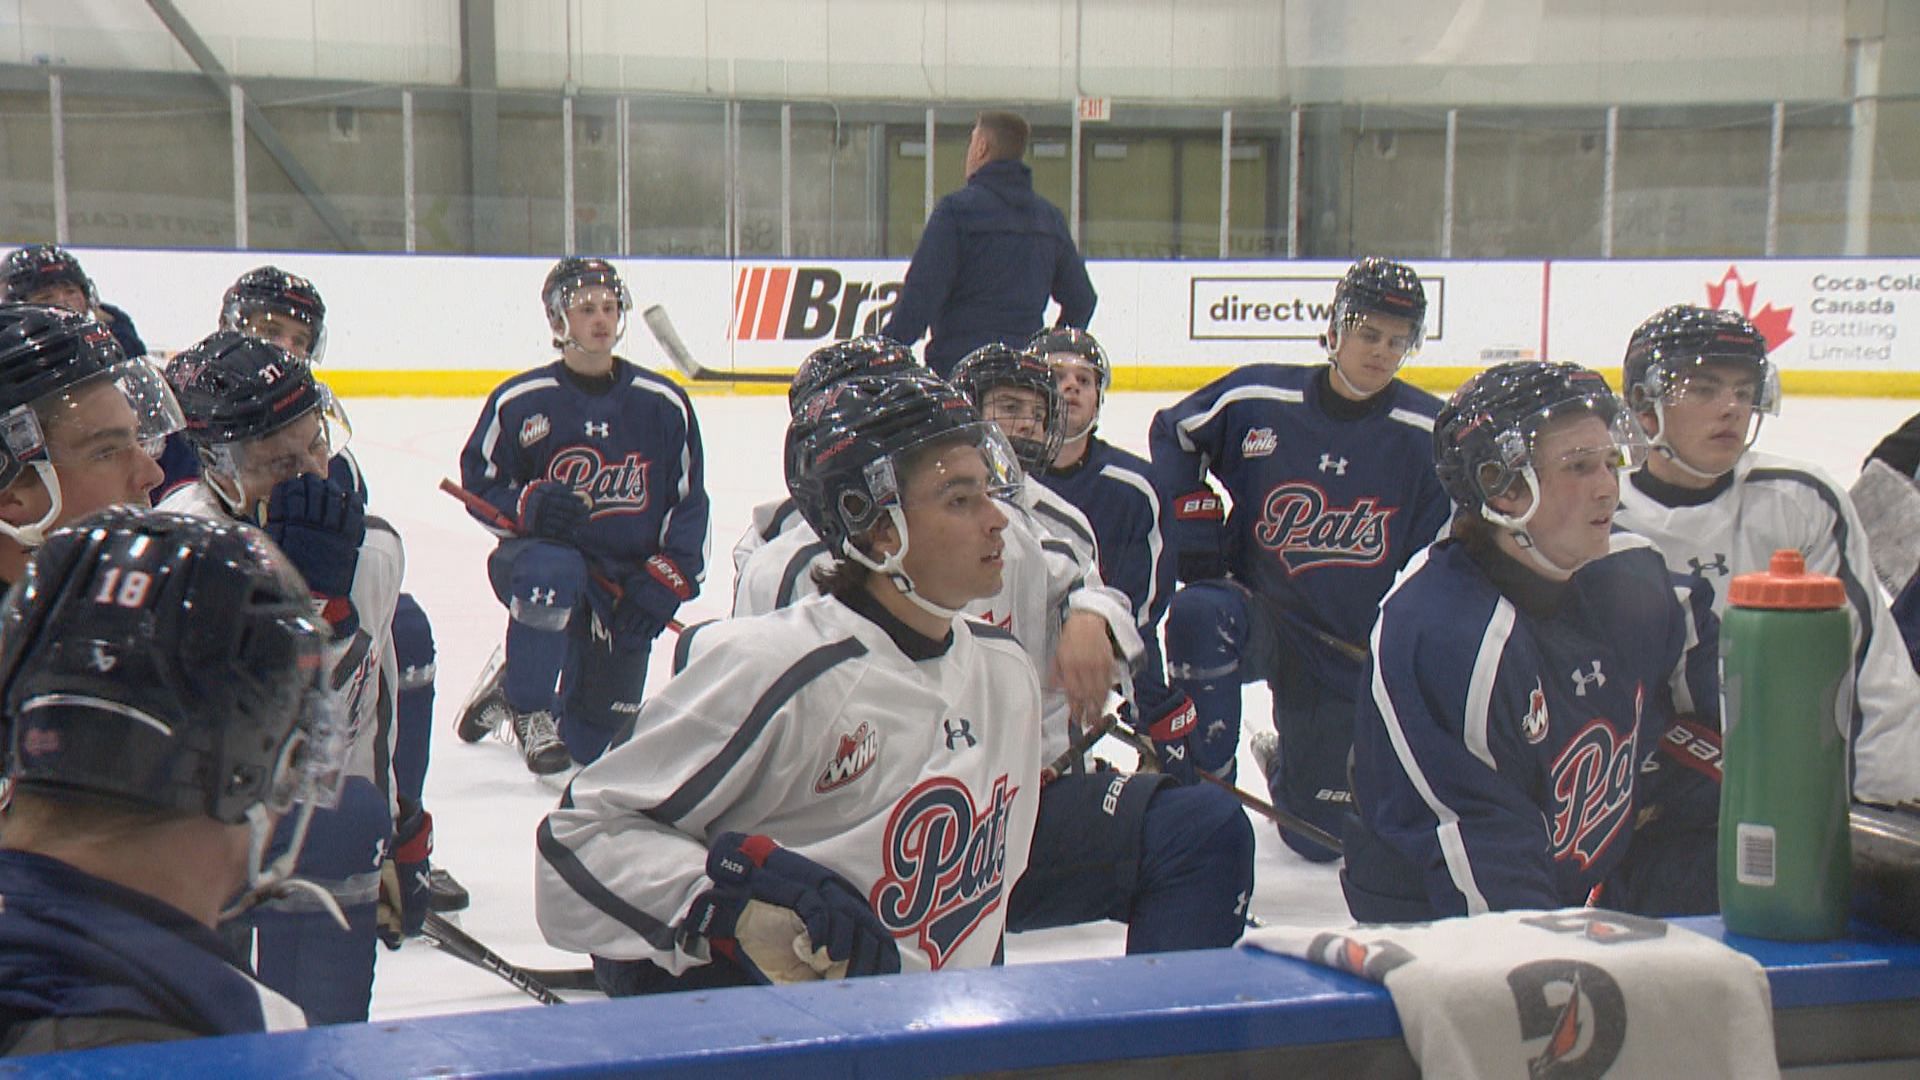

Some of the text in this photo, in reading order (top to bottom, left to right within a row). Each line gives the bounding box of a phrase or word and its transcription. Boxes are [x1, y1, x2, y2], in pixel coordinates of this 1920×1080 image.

[1079, 97, 1105, 118] EXIT
[783, 266, 906, 341] Bra
[1209, 295, 1335, 321] directw
[1811, 297, 1895, 314] Canada
[1810, 320, 1897, 340] Bottling
[1808, 343, 1892, 360] Limited
[548, 447, 652, 519] Pats
[1255, 480, 1400, 575] Pats
[95, 567, 152, 608] 18
